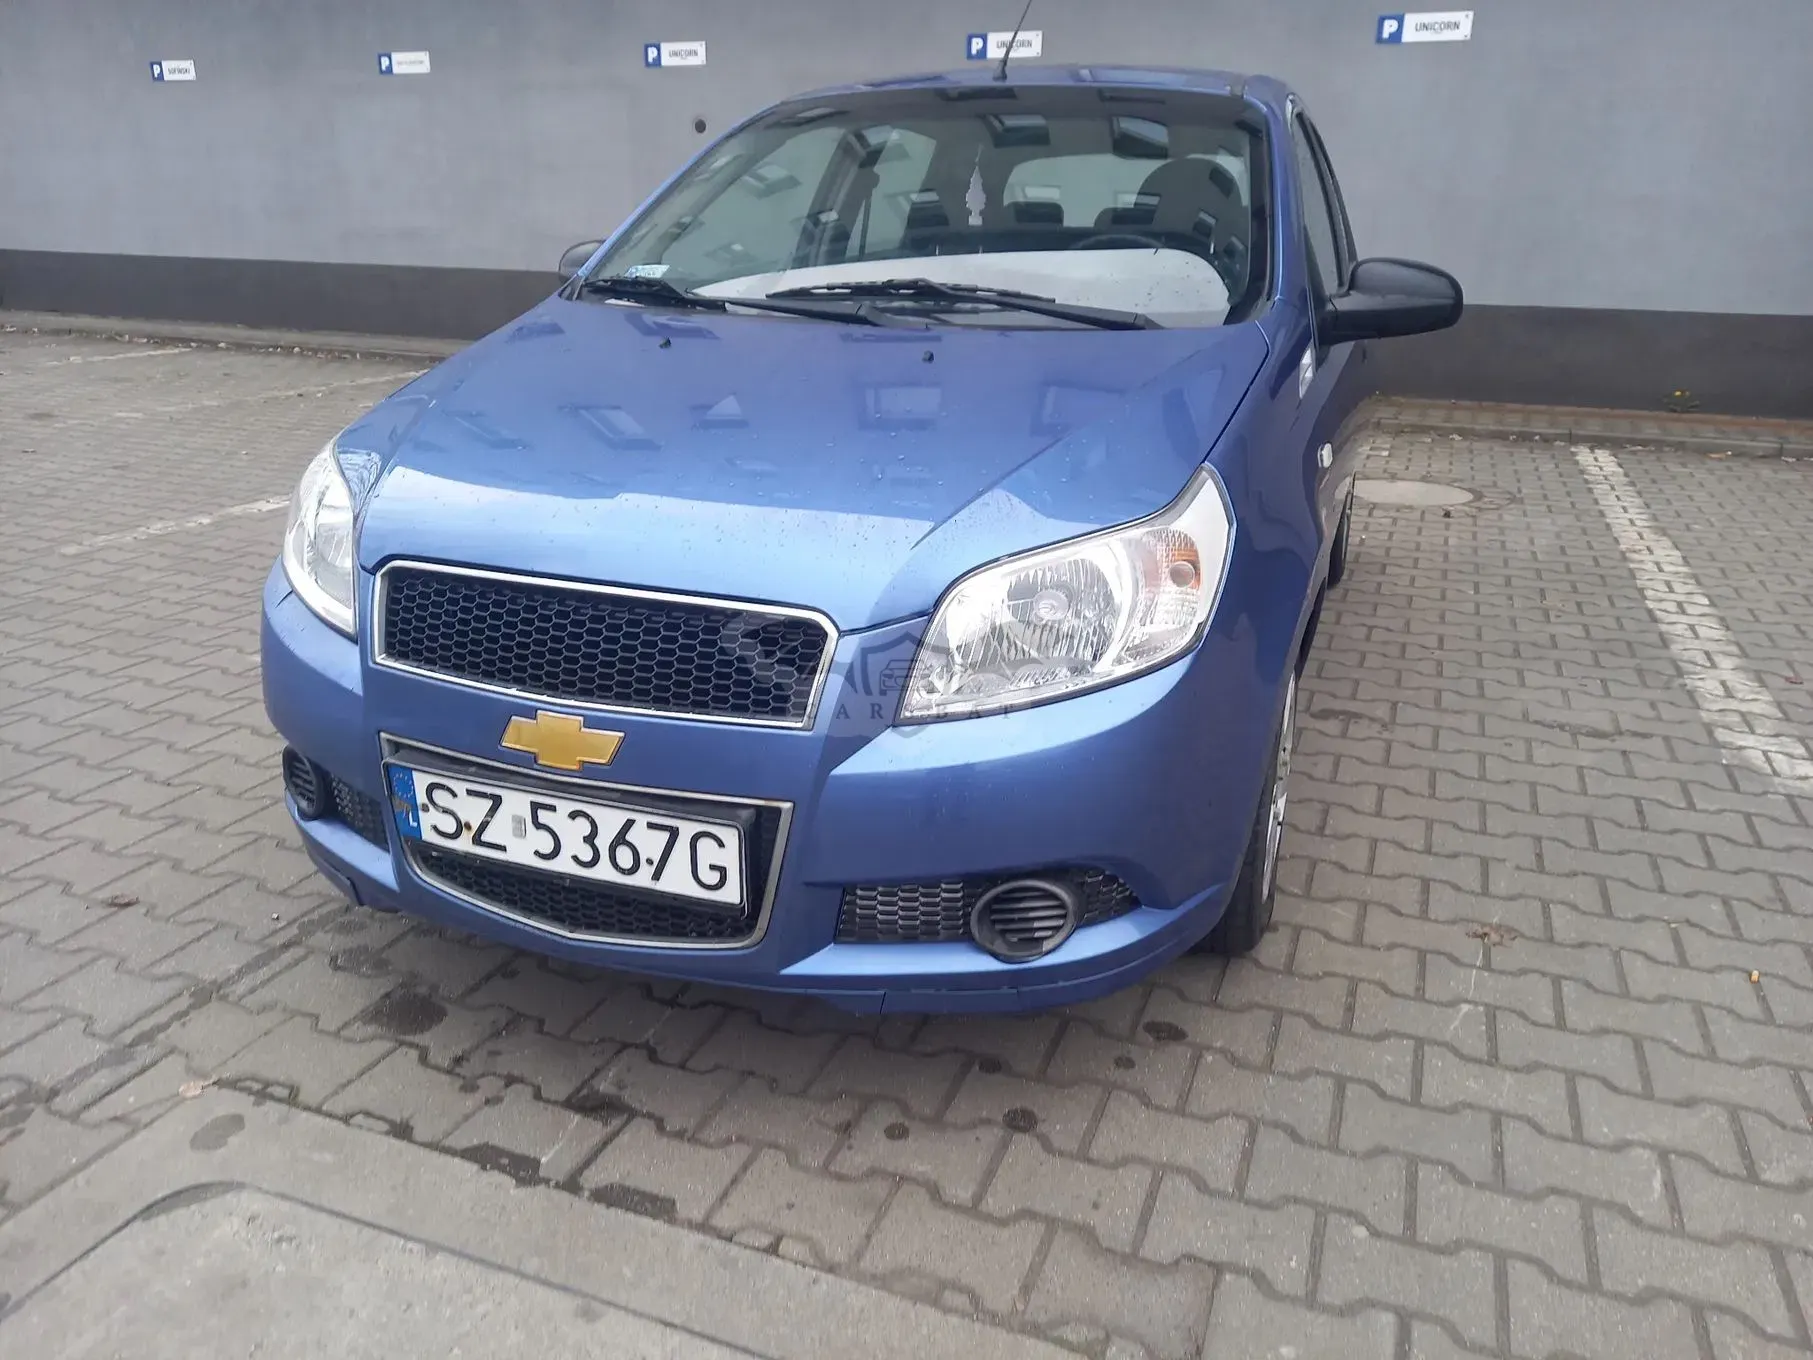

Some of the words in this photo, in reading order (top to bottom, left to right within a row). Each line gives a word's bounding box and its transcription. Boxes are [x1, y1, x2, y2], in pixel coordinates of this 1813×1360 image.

[1382, 19, 1399, 39] P
[1415, 21, 1460, 32] UNICORN
[647, 46, 658, 63] P
[971, 37, 984, 56] P
[153, 64, 161, 78] P
[381, 55, 390, 71] P
[425, 782, 507, 852] SZ
[529, 801, 728, 891] 5367G
